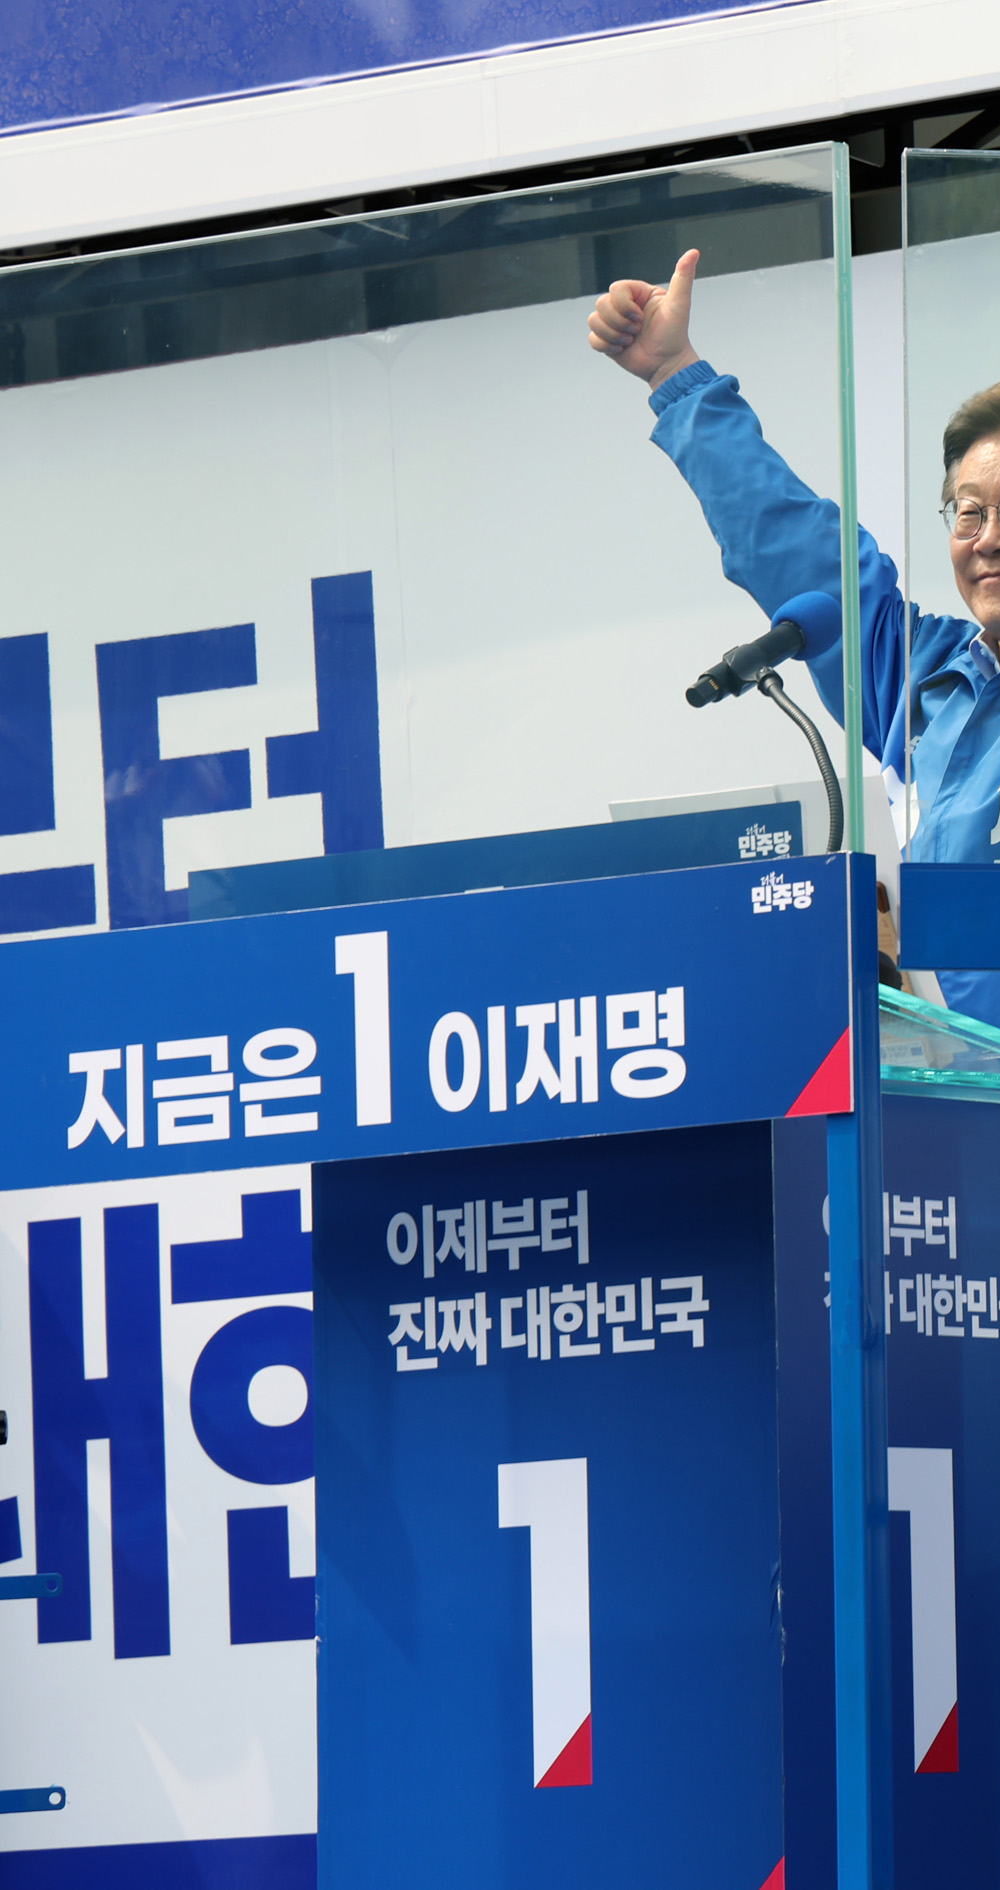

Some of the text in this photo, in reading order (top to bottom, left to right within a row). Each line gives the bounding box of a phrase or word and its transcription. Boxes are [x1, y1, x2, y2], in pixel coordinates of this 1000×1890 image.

[738, 830, 792, 859] 민주당
[751, 880, 815, 914] 민주당
[67, 930, 687, 1150] 지금은 1 이재명
[386, 1189, 590, 1279] 이제부터
[387, 1275, 710, 1372] 진짜 대한민국
[498, 1457, 593, 1789] 1
[888, 1447, 960, 1774] 1
